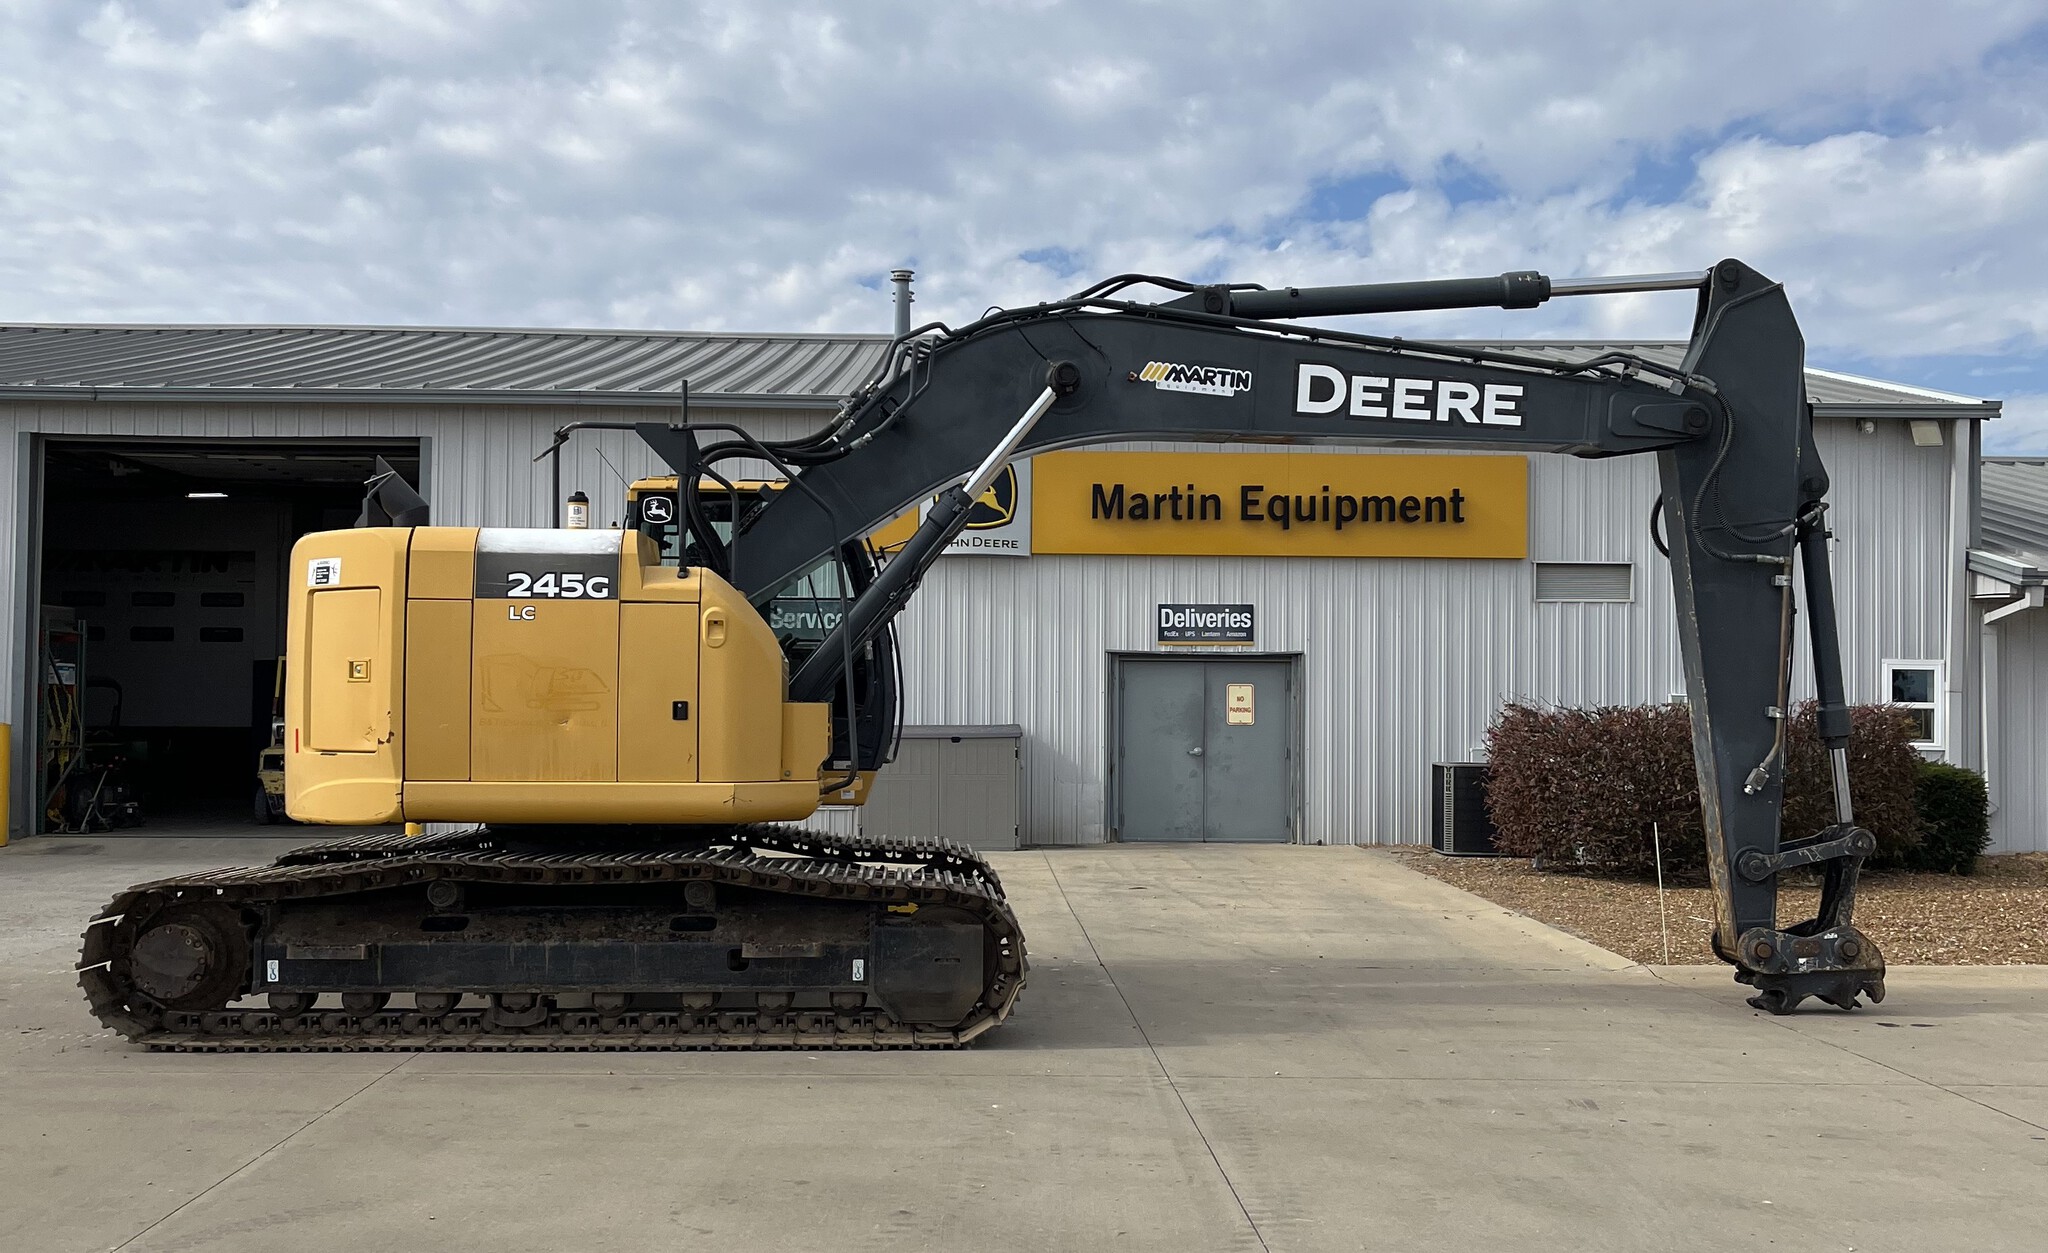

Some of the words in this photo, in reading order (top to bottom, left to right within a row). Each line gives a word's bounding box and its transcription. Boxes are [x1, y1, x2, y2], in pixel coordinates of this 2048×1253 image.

[1164, 365, 1250, 389] MARTIN
[1297, 363, 1524, 426] DEERE
[1091, 483, 1222, 523] Martin
[1240, 485, 1466, 532] Equipment
[972, 537, 1019, 549] DEERE
[507, 572, 609, 599] 245G
[509, 606, 536, 620] LC
[1160, 608, 1252, 628] Deliveries
